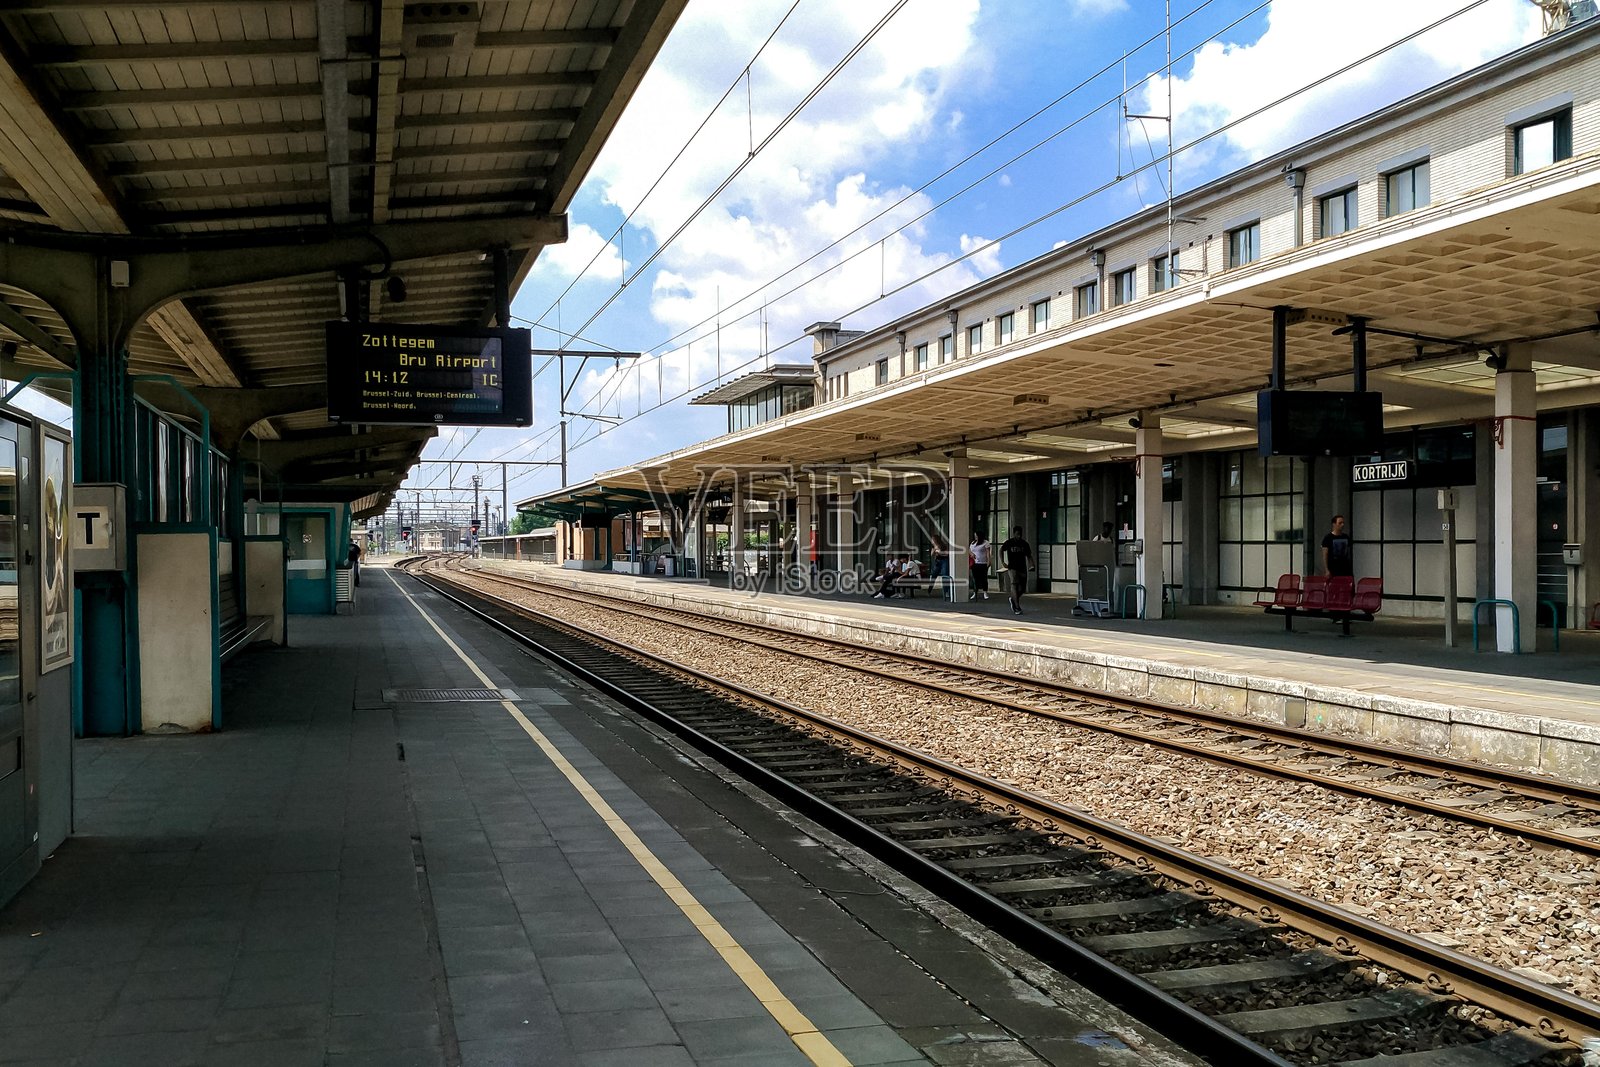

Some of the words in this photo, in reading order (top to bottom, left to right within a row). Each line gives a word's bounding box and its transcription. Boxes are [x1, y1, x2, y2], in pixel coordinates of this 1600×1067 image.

[362, 334, 435, 349] Zottegem
[400, 353, 426, 366] Bru
[436, 354, 496, 368] Airport
[364, 370, 408, 384] 14:12
[482, 374, 498, 386] IC
[1355, 463, 1405, 480] KORTRIJK
[77, 512, 101, 545] T
